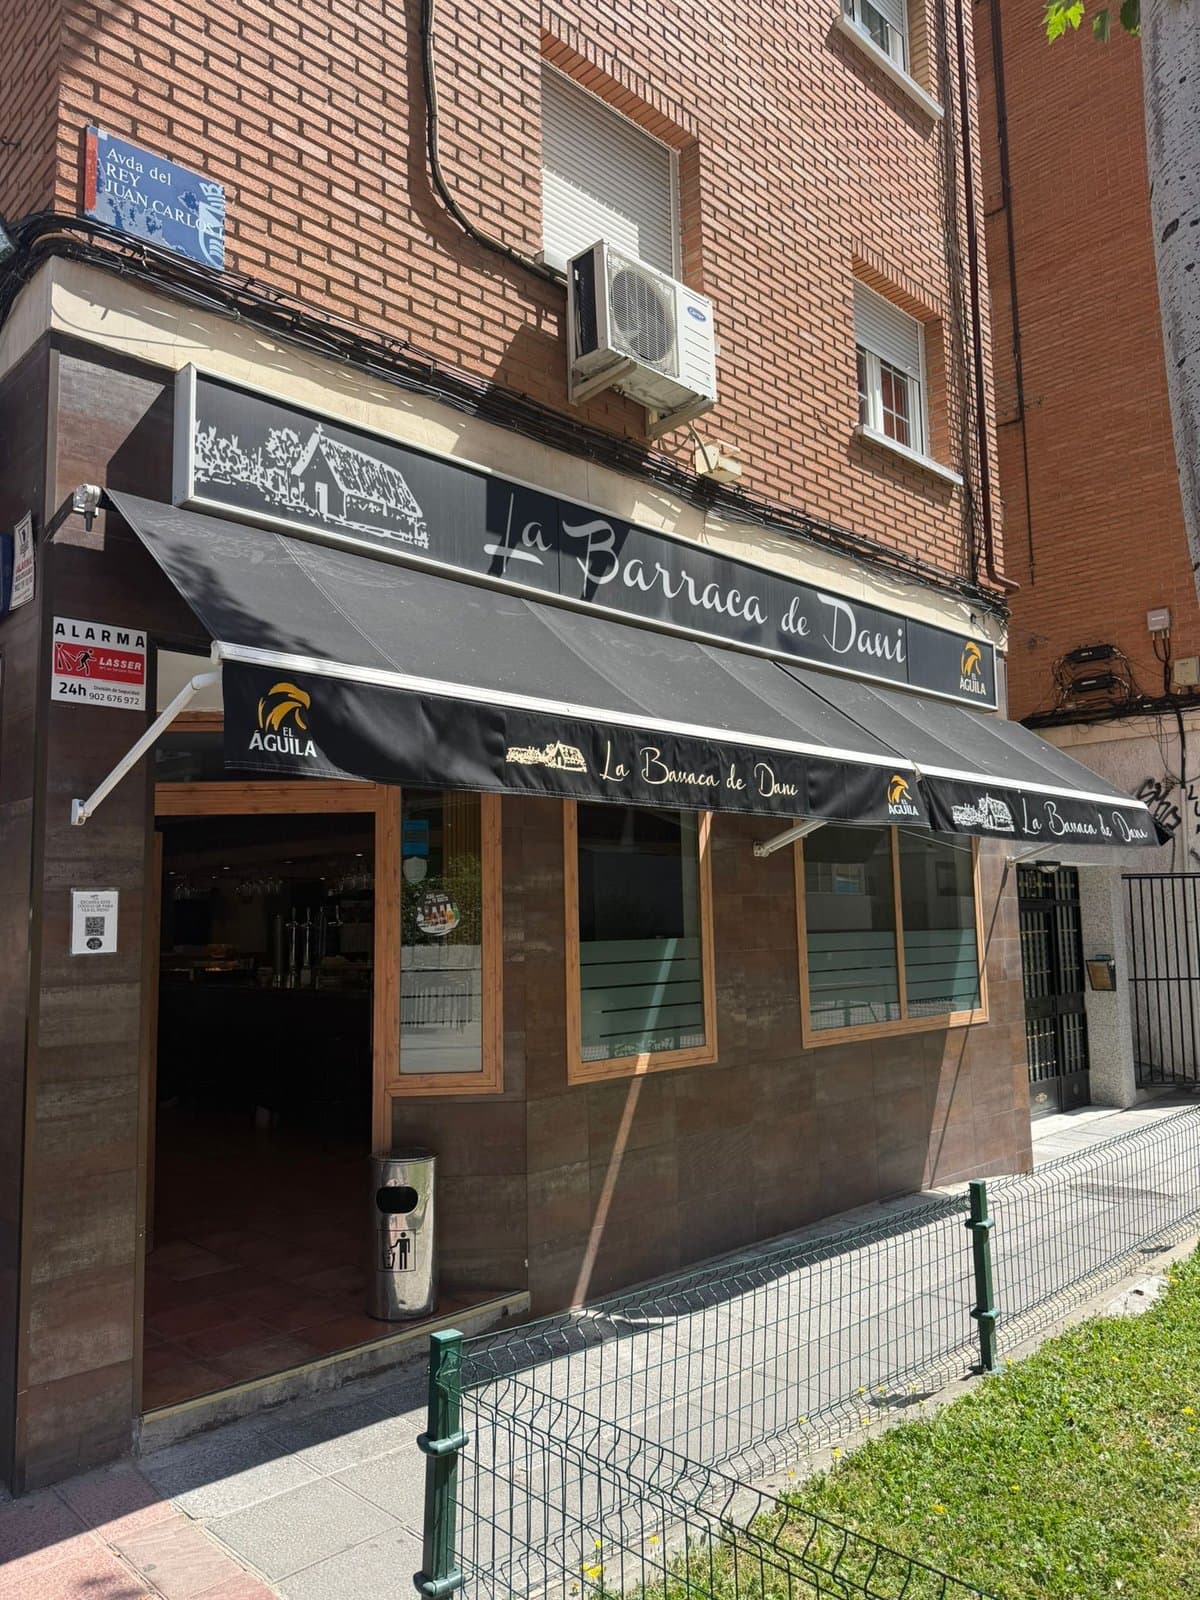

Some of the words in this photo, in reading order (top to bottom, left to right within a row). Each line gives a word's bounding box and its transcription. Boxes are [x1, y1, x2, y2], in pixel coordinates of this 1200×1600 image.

[106, 148, 144, 174] Avda
[149, 167, 172, 186] del
[106, 162, 141, 188] REY
[104, 179, 148, 208] JUAN
[484, 493, 552, 574] La
[562, 520, 768, 626] Barraca
[781, 596, 811, 637] de
[817, 592, 907, 663] Dani
[55, 623, 145, 648] ALARMA
[99, 657, 142, 671] LASSER
[58, 682, 87, 696] 24h
[88, 692, 105, 702] 902
[106, 694, 123, 704] 676
[123, 696, 141, 706] 972
[249, 730, 318, 758] ÁGUILA
[282, 726, 294, 738] EL
[600, 740, 630, 783] La
[726, 763, 747, 791] de
[754, 762, 800, 798] Dani
[1022, 798, 1042, 835] La
[1098, 813, 1113, 838] de
